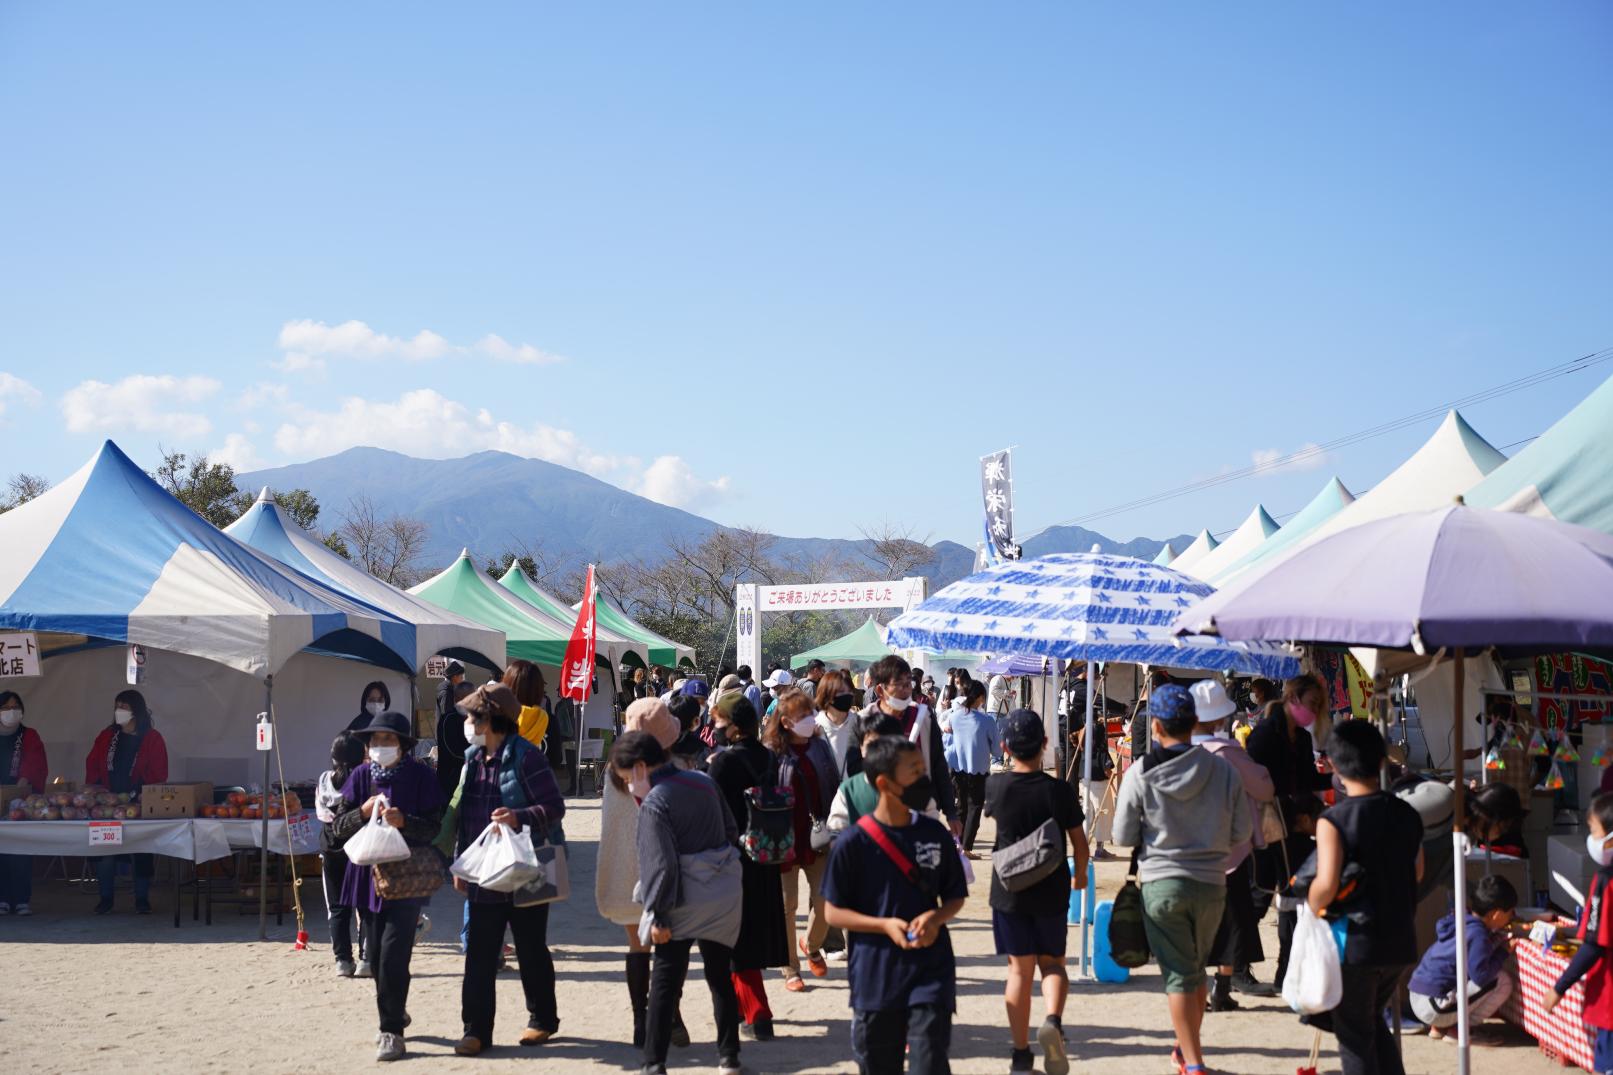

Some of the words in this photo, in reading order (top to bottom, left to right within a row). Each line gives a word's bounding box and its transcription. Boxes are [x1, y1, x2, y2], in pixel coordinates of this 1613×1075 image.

[768, 588, 891, 605] ご来場ありがとうございました
